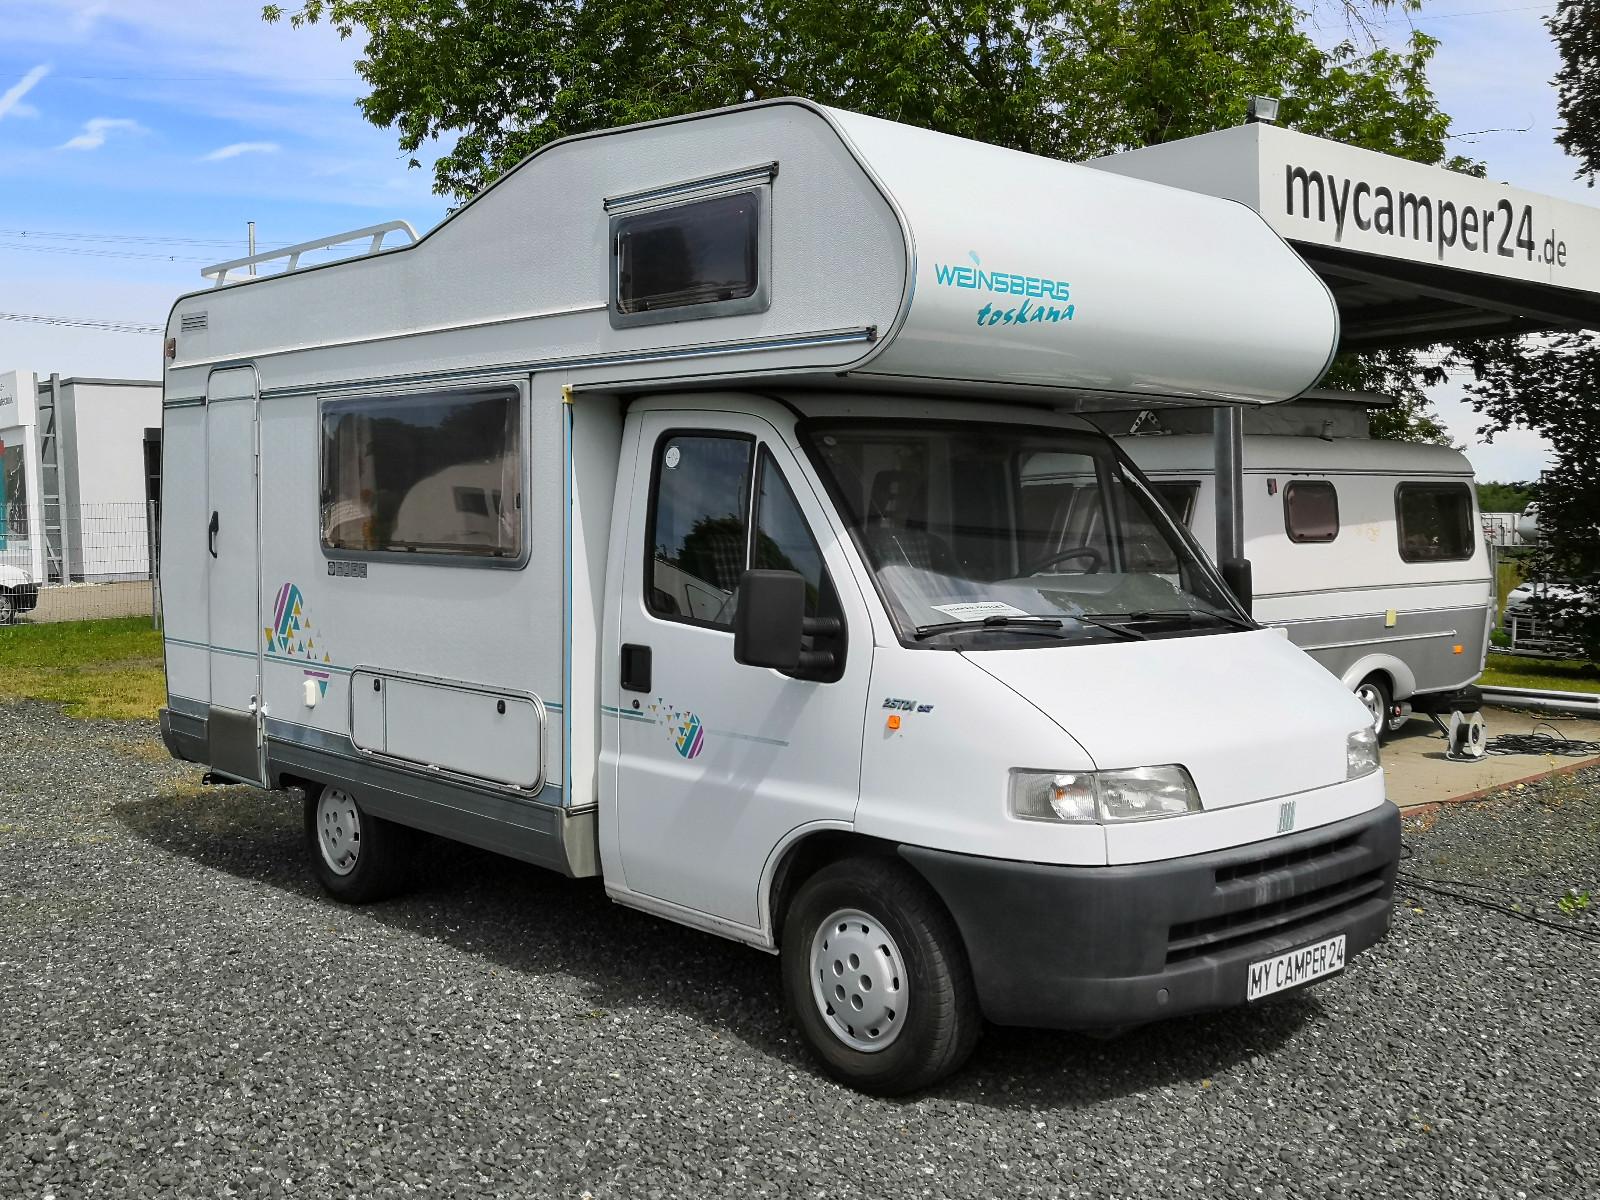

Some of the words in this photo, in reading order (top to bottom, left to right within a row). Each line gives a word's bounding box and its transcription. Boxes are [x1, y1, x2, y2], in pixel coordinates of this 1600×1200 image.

[935, 263, 1070, 301] WEINSBERG
[976, 298, 1075, 326] toskana
[1250, 961, 1272, 996] MY
